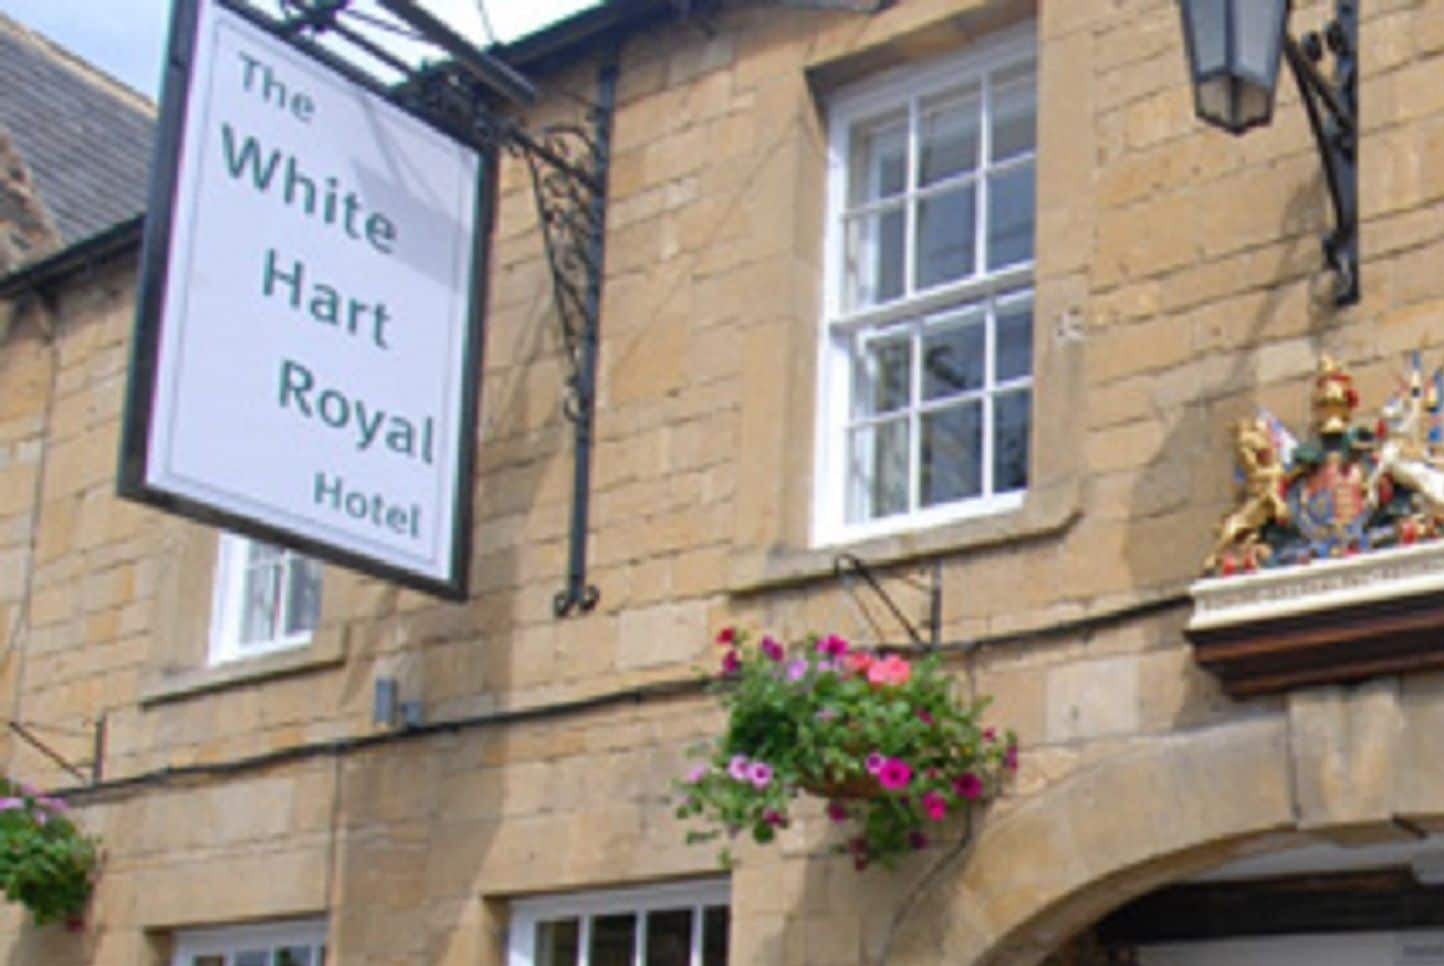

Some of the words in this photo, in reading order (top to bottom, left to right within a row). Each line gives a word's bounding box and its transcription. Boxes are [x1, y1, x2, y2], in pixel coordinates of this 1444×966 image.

[239, 52, 315, 122] The
[220, 122, 398, 255] White
[261, 248, 392, 350] Hart
[278, 359, 434, 464] Royal
[313, 471, 421, 540] Hotel
